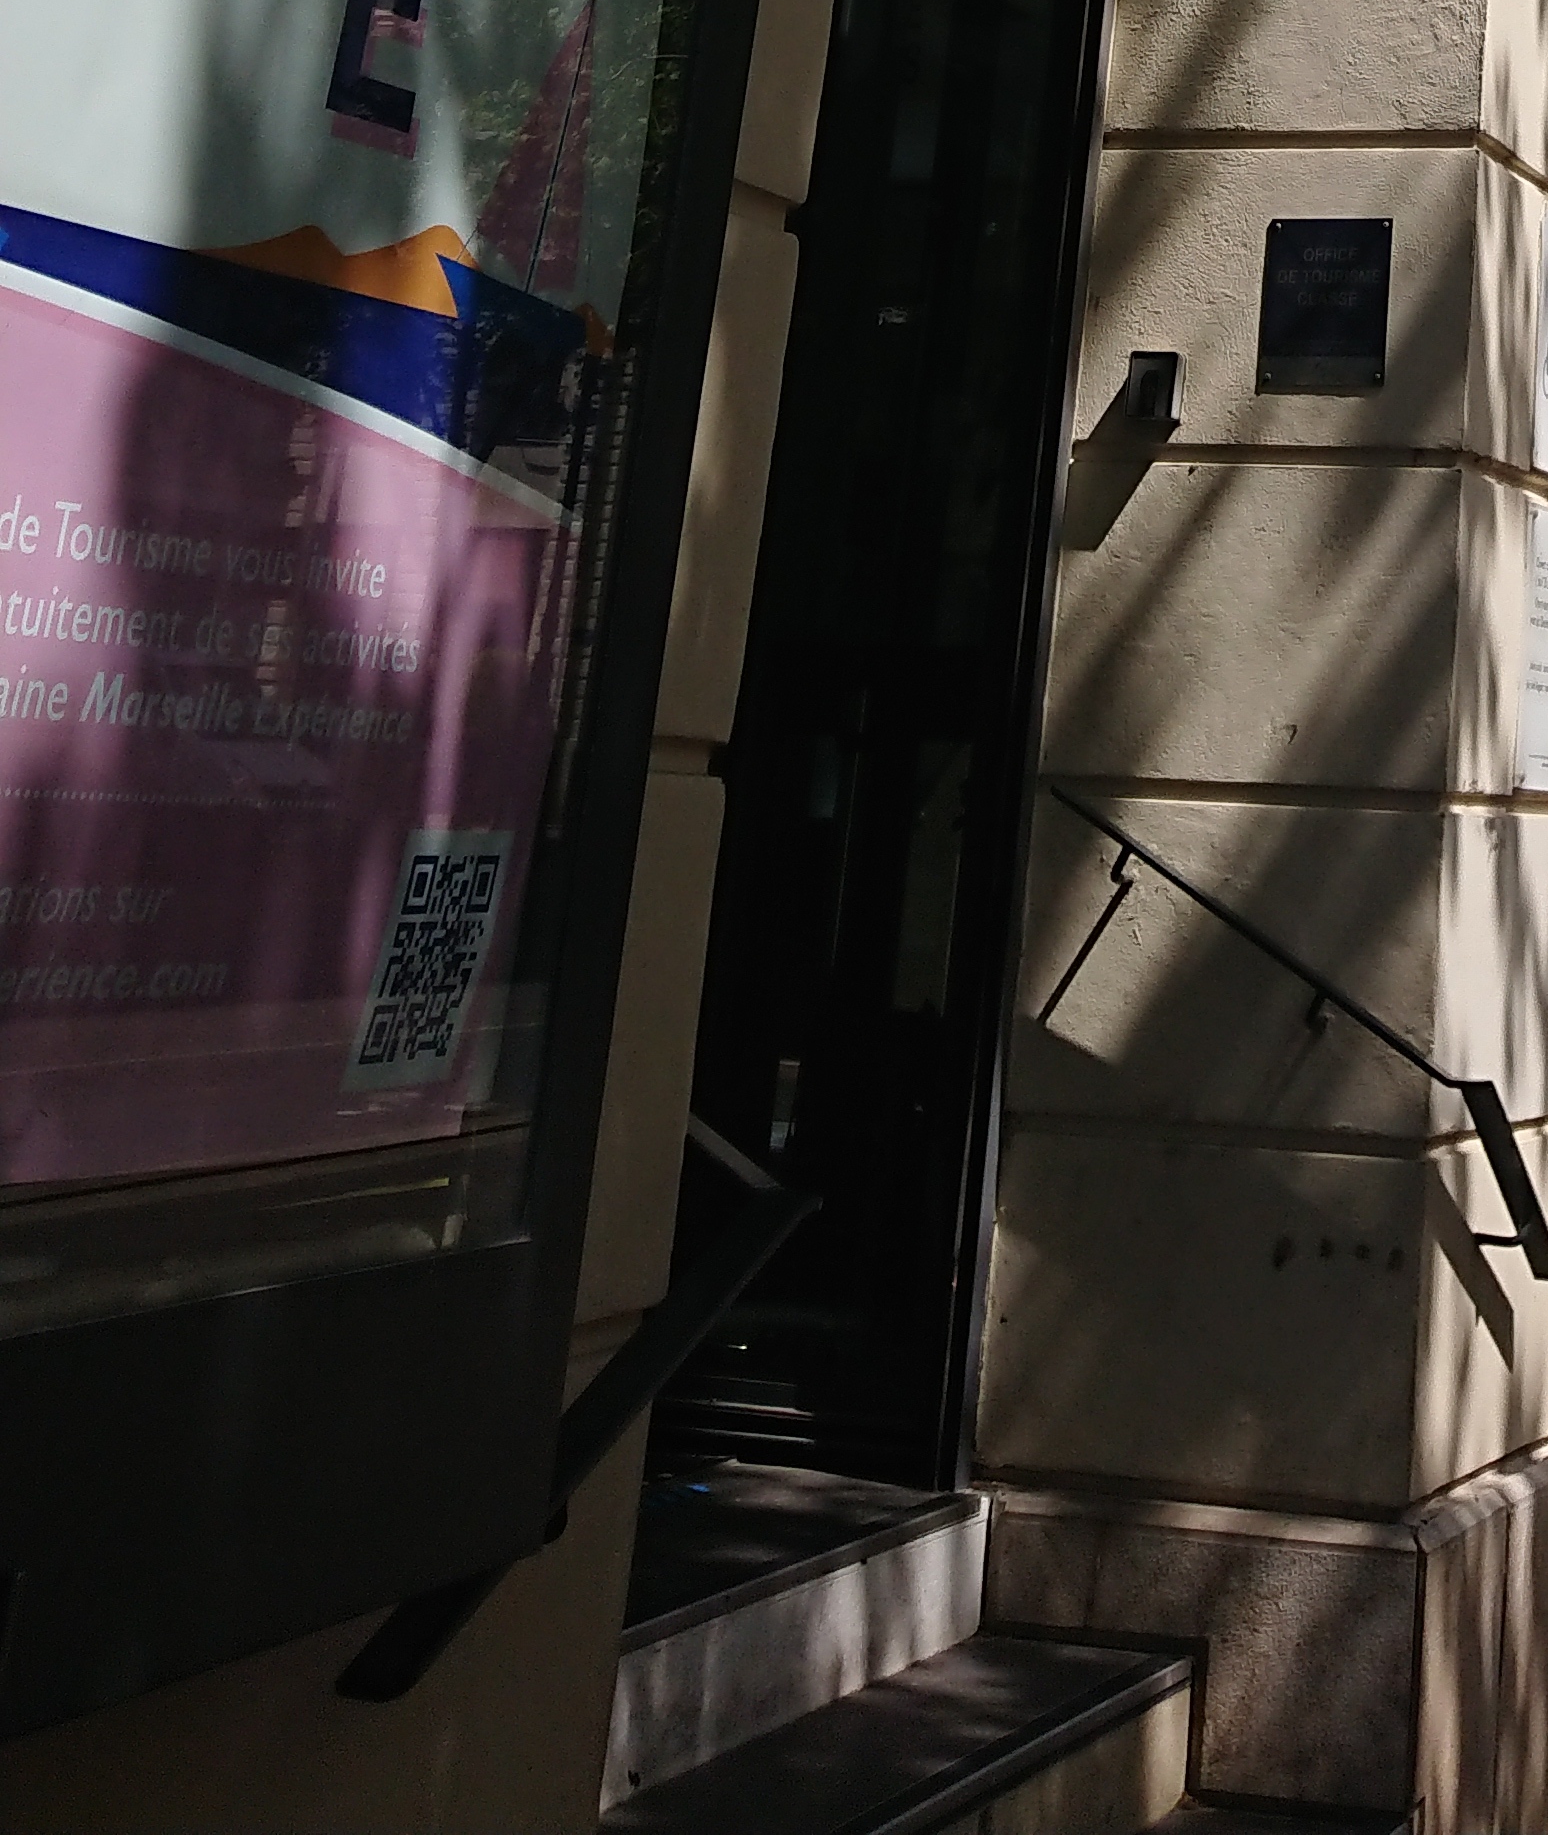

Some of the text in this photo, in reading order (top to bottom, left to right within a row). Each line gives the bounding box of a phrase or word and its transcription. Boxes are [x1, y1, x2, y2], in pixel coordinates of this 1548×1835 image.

[54, 500, 211, 574] Tourisme
[226, 545, 293, 585] vous
[305, 543, 387, 598] invite
[0, 585, 182, 650] tuitement
[195, 602, 232, 656] de
[303, 620, 421, 674] activités
[79, 671, 242, 733] Marseille
[108, 886, 177, 924] sur
